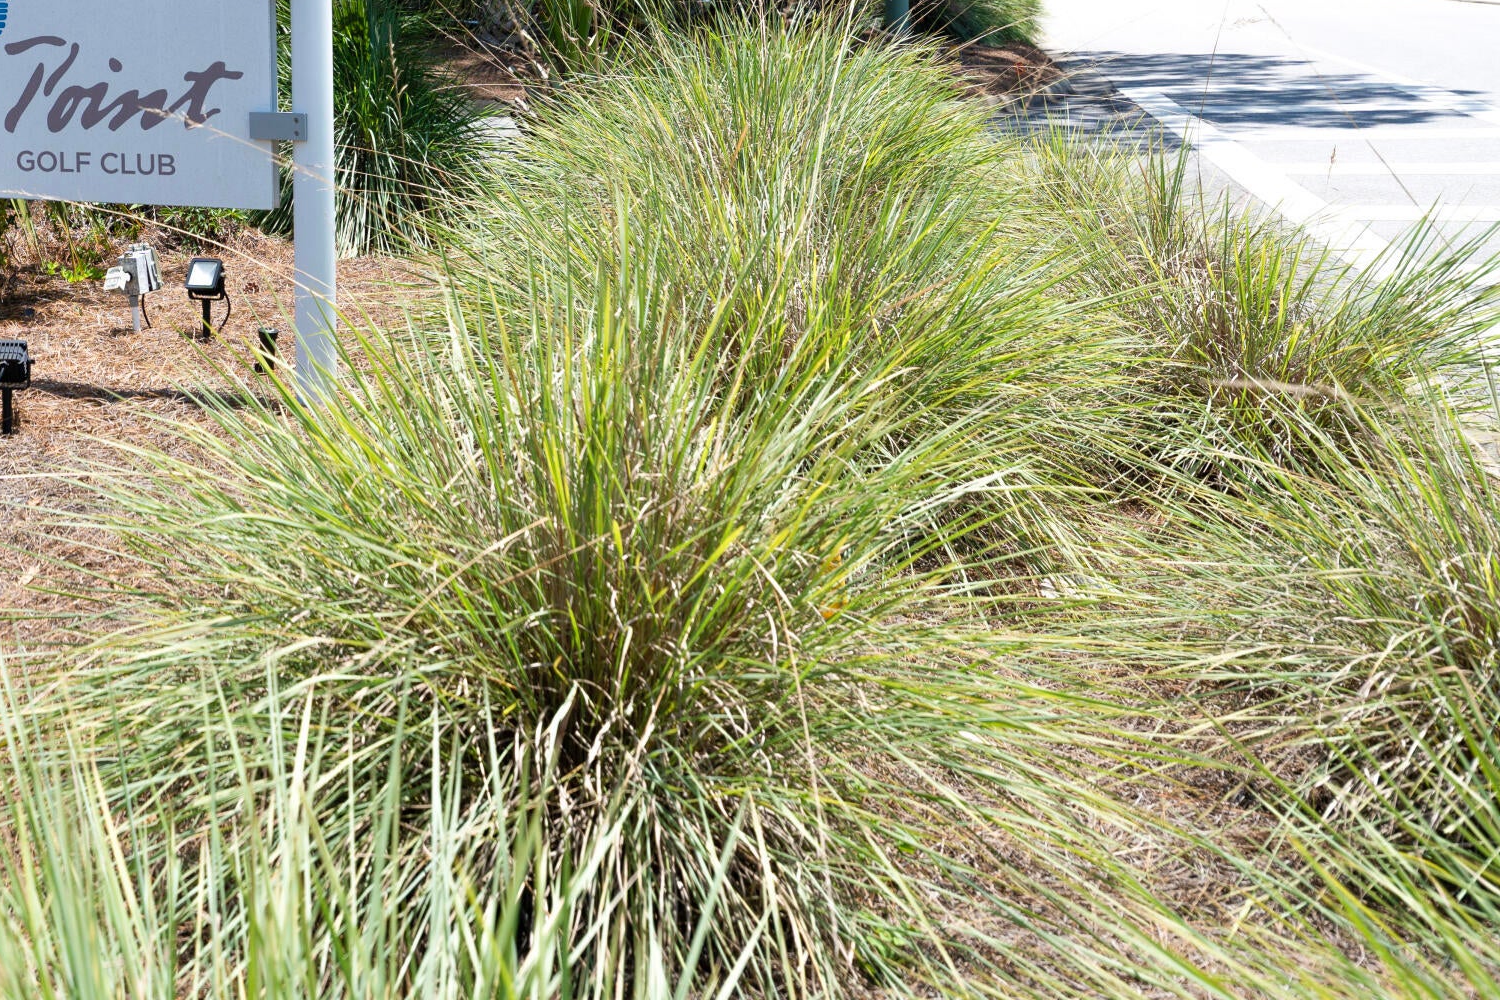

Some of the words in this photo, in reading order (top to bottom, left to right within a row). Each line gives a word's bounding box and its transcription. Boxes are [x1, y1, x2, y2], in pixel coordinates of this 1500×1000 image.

[4, 35, 244, 135] Point
[16, 151, 91, 174] GOLF
[100, 152, 176, 176] CLUB
